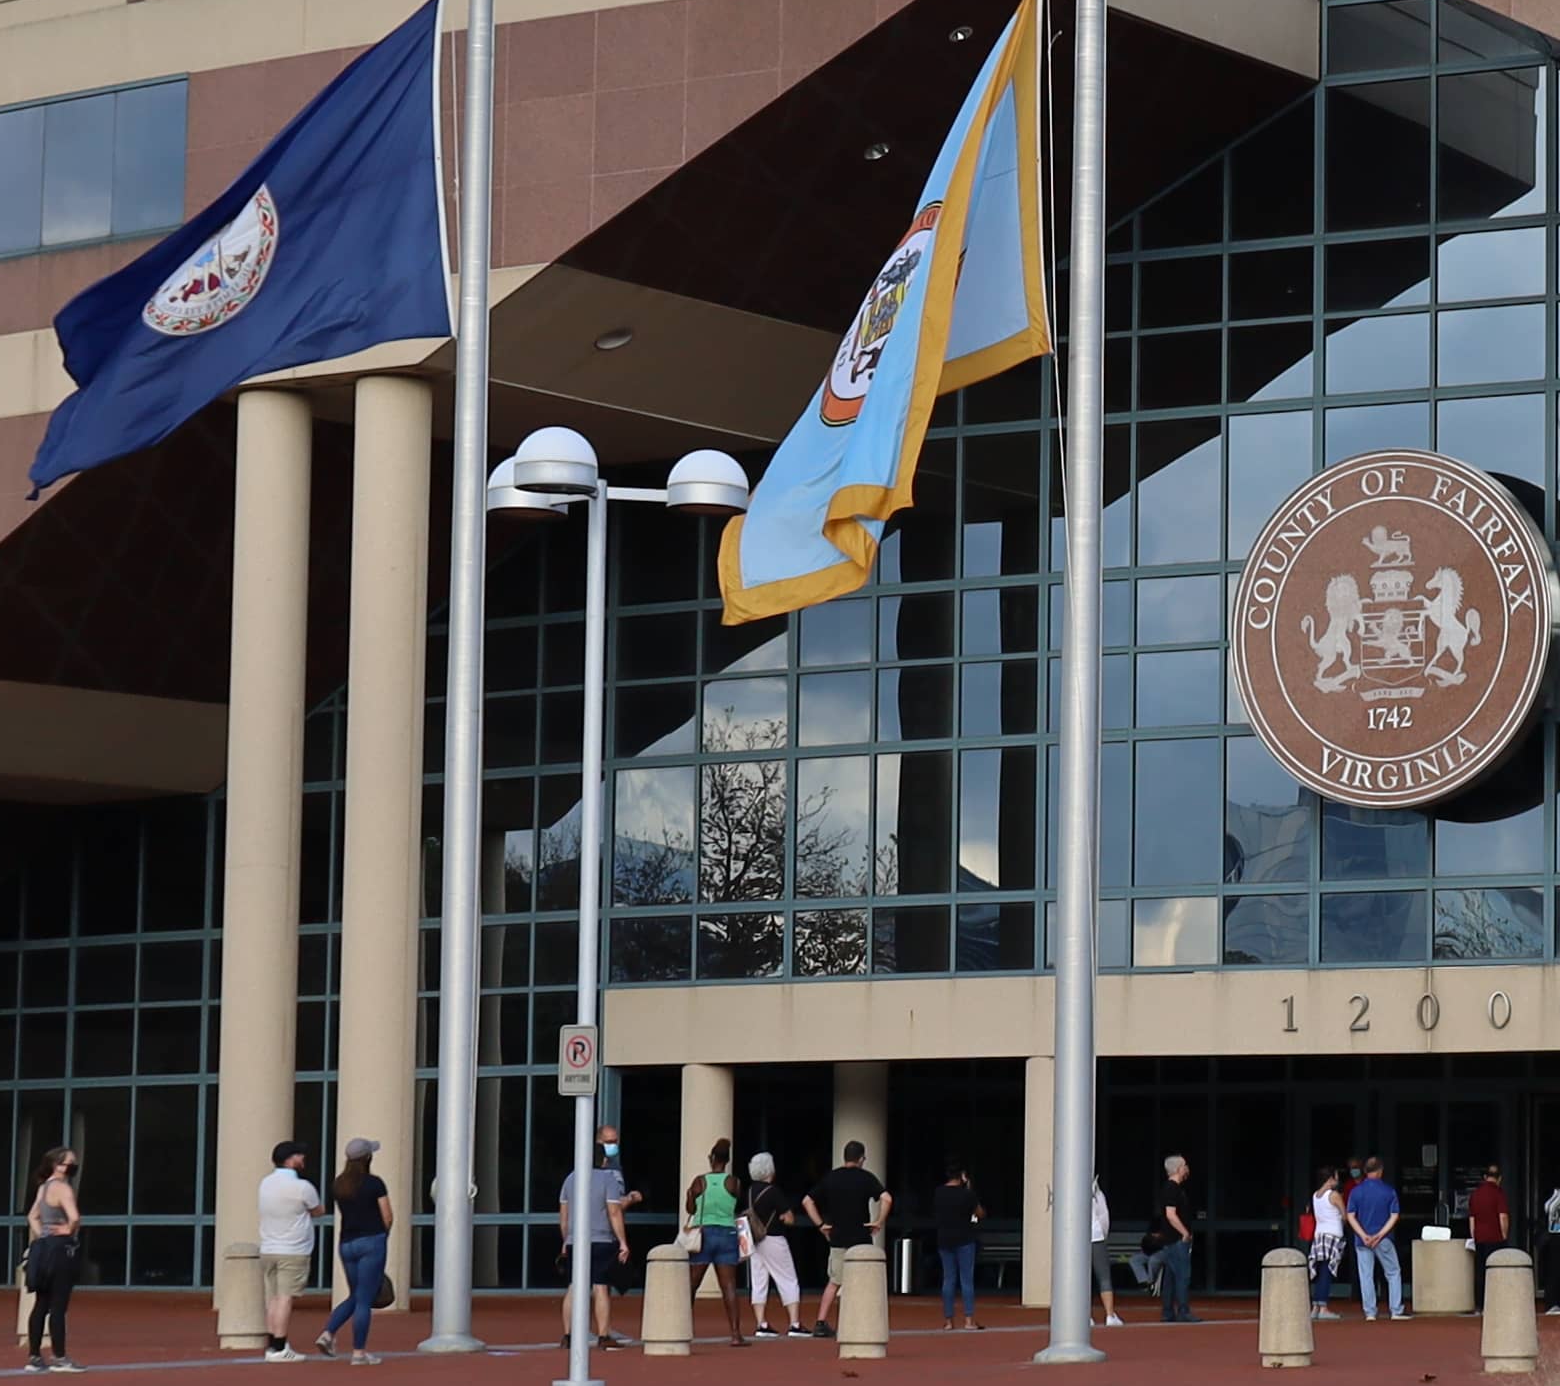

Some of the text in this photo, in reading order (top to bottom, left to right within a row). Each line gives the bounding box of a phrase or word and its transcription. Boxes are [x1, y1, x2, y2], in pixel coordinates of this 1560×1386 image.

[1248, 468, 1535, 630] COUNTY OF FAIRFAX
[1366, 706, 1413, 731] 1742
[1318, 734, 1480, 790] VIRGINIA
